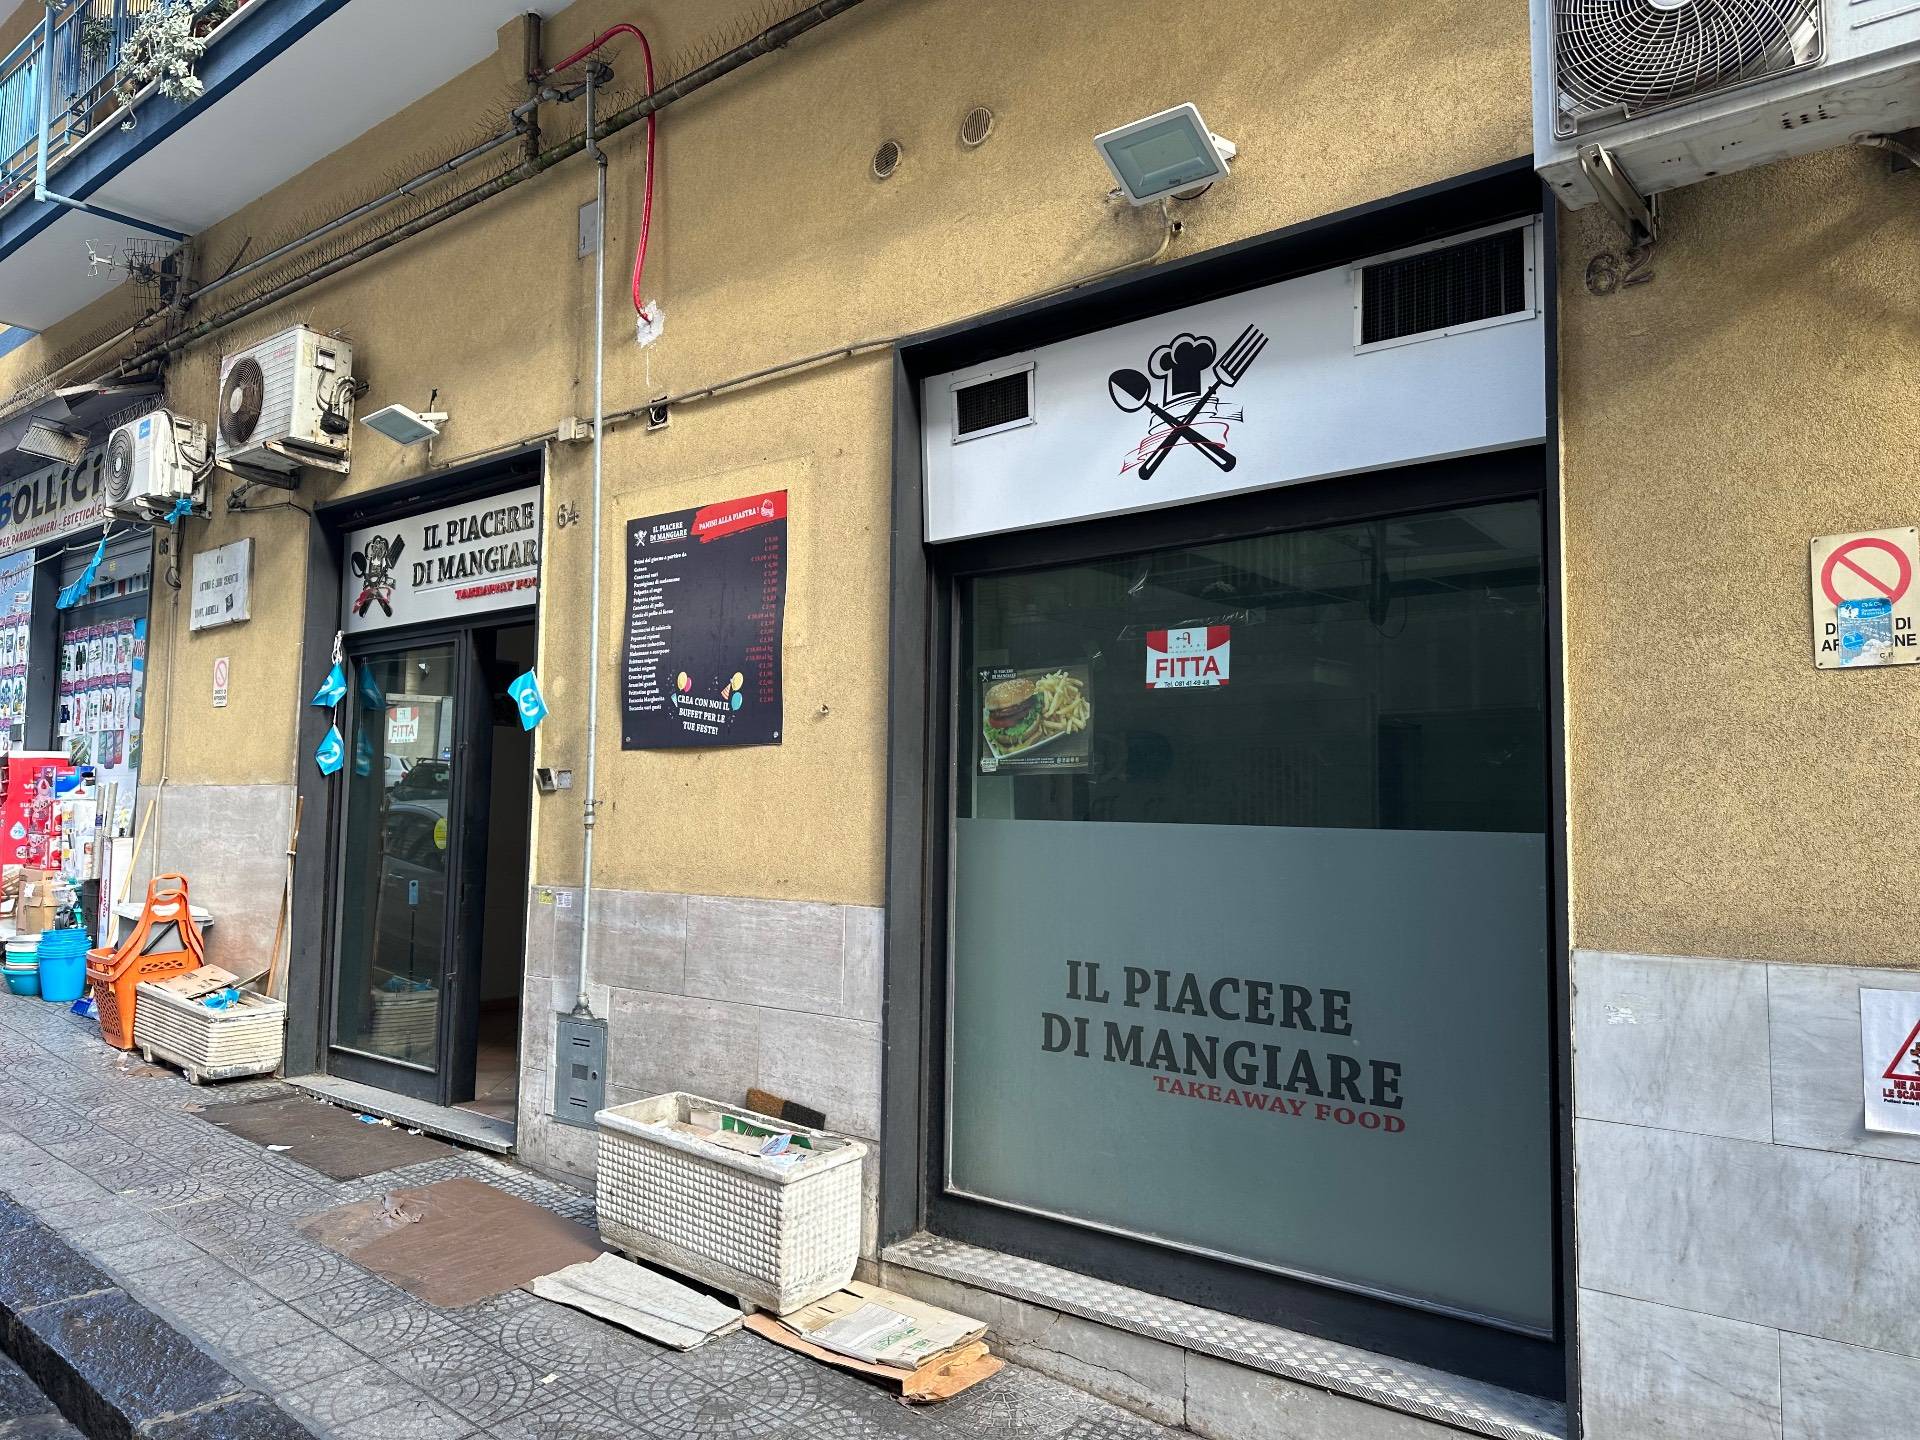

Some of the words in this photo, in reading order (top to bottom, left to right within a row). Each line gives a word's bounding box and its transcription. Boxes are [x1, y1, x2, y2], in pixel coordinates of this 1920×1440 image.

[1585, 248, 1653, 296] 62
[556, 500, 580, 528] 64
[698, 520, 718, 530] PANINI
[718, 515, 732, 525] ALLA
[732, 509, 756, 521] PIASTRA
[11, 520, 57, 544] PARRUCCHIERI
[62, 508, 94, 527] ESTETICA
[423, 524, 442, 551] IL
[446, 501, 535, 546] PIACERE
[652, 525, 659, 533] IL
[659, 521, 683, 533] PIACERE
[657, 528, 688, 541] MANGIARE
[411, 560, 433, 587] DI
[437, 538, 538, 581] MANGIAR
[1895, 617, 1911, 630] DI
[1156, 655, 1220, 678] FITTA
[678, 695, 693, 705] CREA
[695, 697, 708, 707] CON
[709, 700, 722, 709] NOI
[723, 701, 730, 711] IL
[679, 707, 703, 719] BUFFET
[703, 711, 716, 722] PER
[717, 714, 726, 723] LE
[392, 724, 415, 737] FITTA
[683, 721, 696, 731] TUE
[696, 723, 718, 735] FESTE!
[1066, 959, 1110, 1003] IL
[1123, 966, 1353, 1036] PIACERE
[1041, 1012, 1090, 1058] DI
[1103, 1020, 1403, 1110] MANGIARE
[1153, 1075, 1306, 1117] TAKEAWAY
[1314, 1103, 1406, 1133] FOOD
[1883, 1088, 1895, 1098] LE
